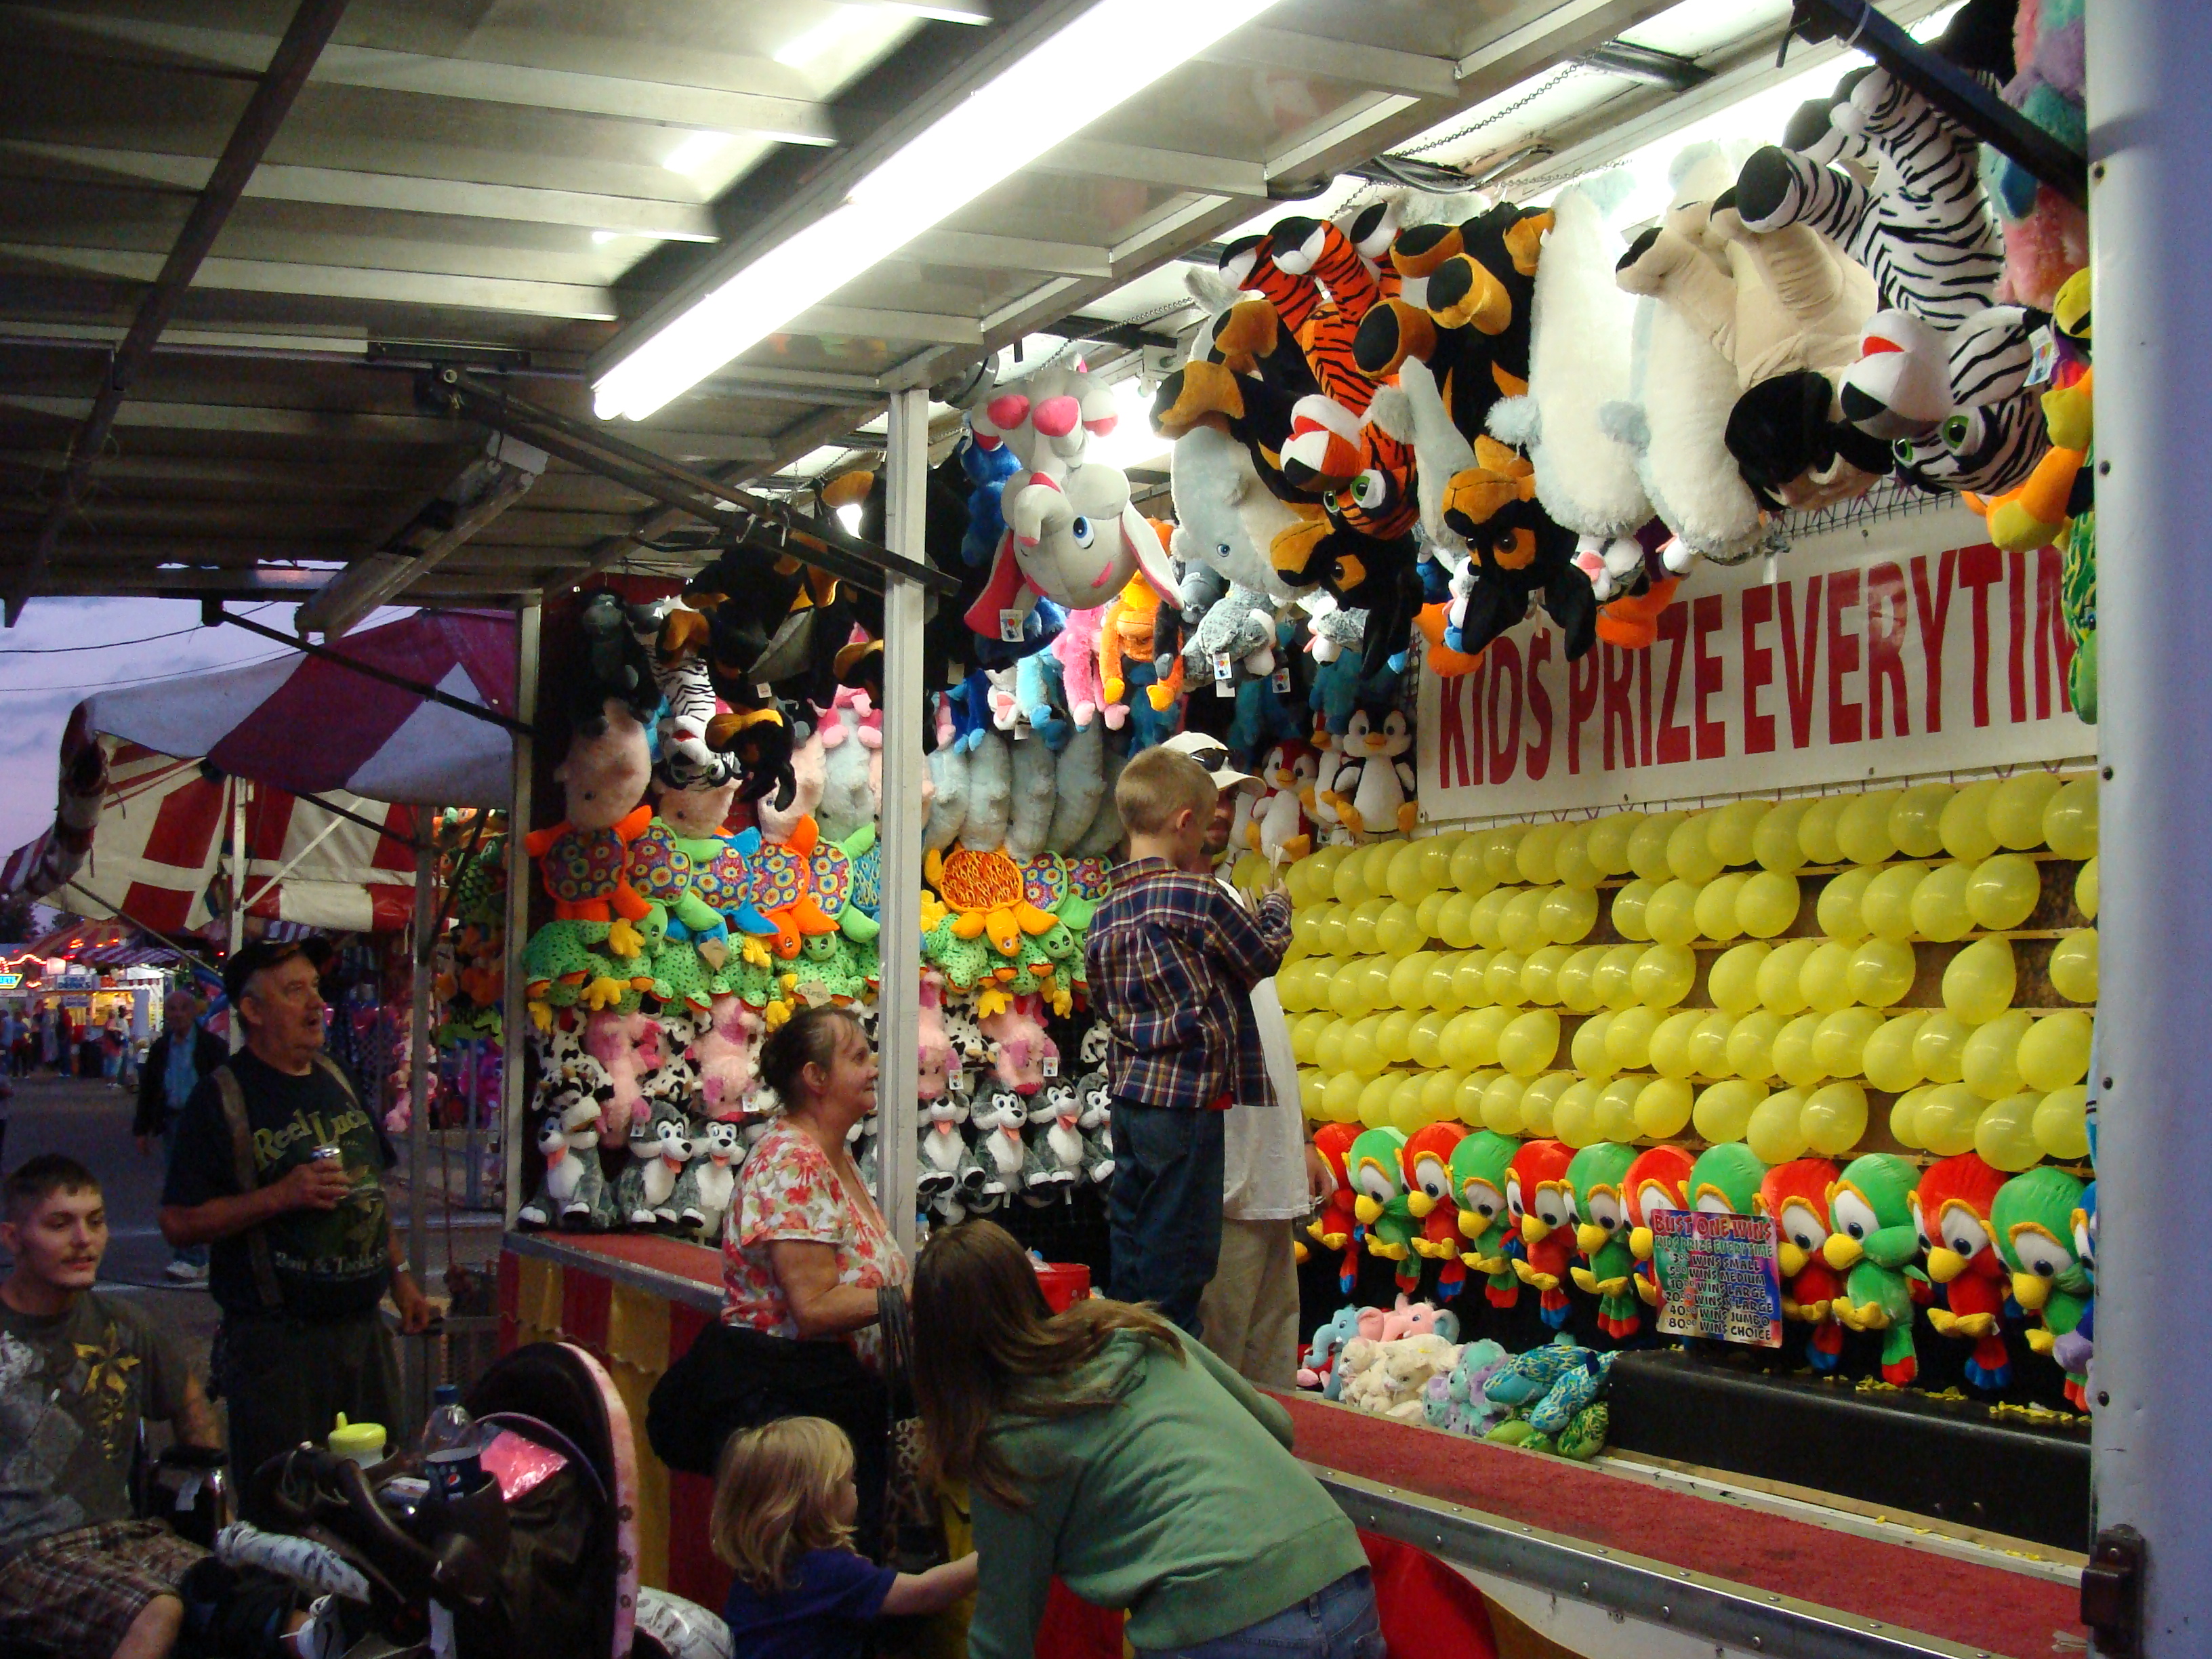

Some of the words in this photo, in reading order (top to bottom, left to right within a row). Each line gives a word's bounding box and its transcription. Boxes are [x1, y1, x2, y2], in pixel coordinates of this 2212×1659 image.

[1440, 627, 1552, 789] KIDS
[1568, 594, 1725, 775] PRIZE
[1654, 1214, 1693, 1235] BUST
[1696, 1216, 1729, 1238] ONE
[1732, 1220, 1771, 1242] WINS
[1655, 1235, 1679, 1251] KIDS
[1681, 1237, 1713, 1253] PRIZE
[1692, 1254, 1721, 1267] WINS
[1723, 1257, 1761, 1272] SMALL
[1688, 1267, 1717, 1279] WINS
[1720, 1271, 1766, 1286] MEDIUM
[1696, 1281, 1725, 1294] WINS
[1727, 1284, 1766, 1299] LARGE
[1694, 1294, 1722, 1307] WINS
[1699, 1307, 1727, 1321] WINS
[1730, 1311, 1771, 1327] JUMBO
[1700, 1321, 1728, 1334] WINS
[1730, 1326, 1771, 1340] CHOICE
